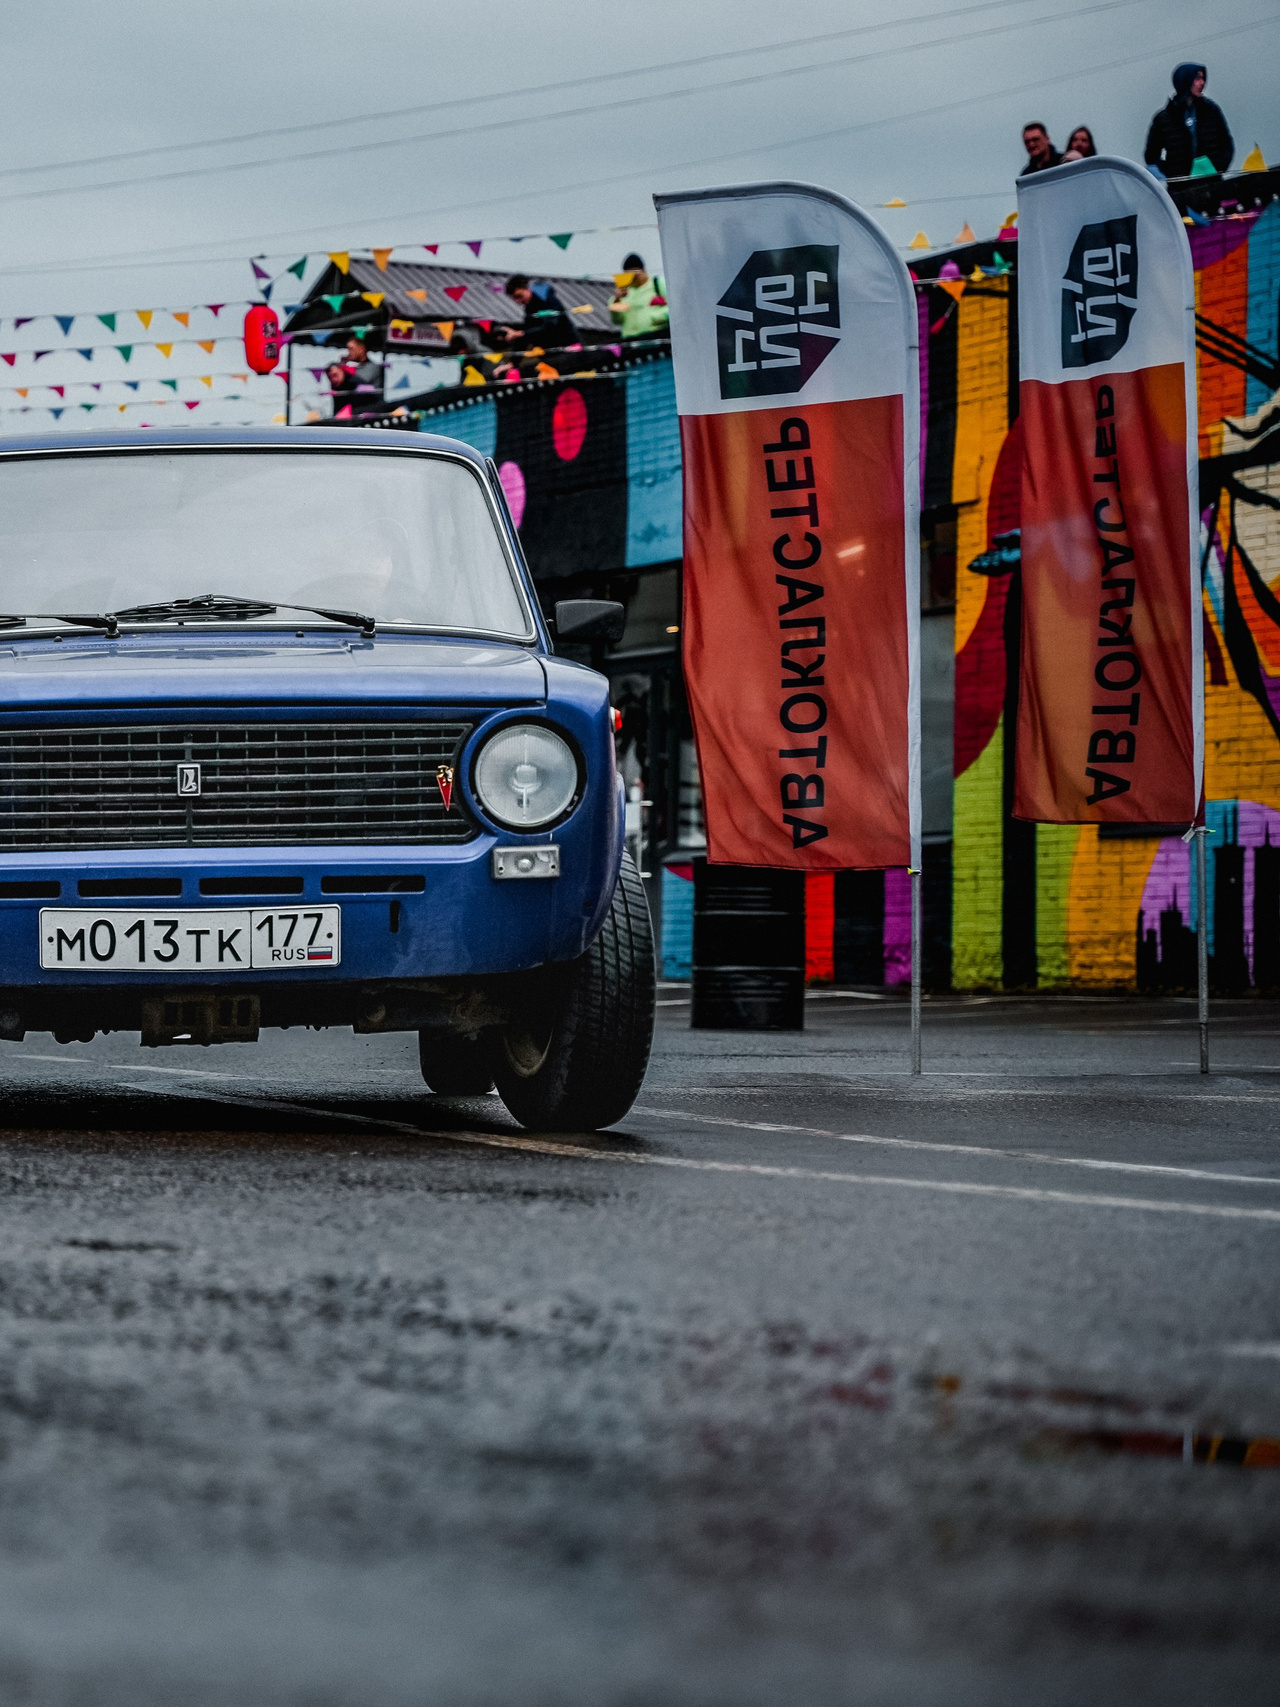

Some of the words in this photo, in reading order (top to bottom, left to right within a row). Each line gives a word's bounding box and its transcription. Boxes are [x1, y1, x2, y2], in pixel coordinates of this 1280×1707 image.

[56, 918, 243, 963] М013ТК
[256, 913, 323, 947] 177
[271, 948, 306, 961] RUS
